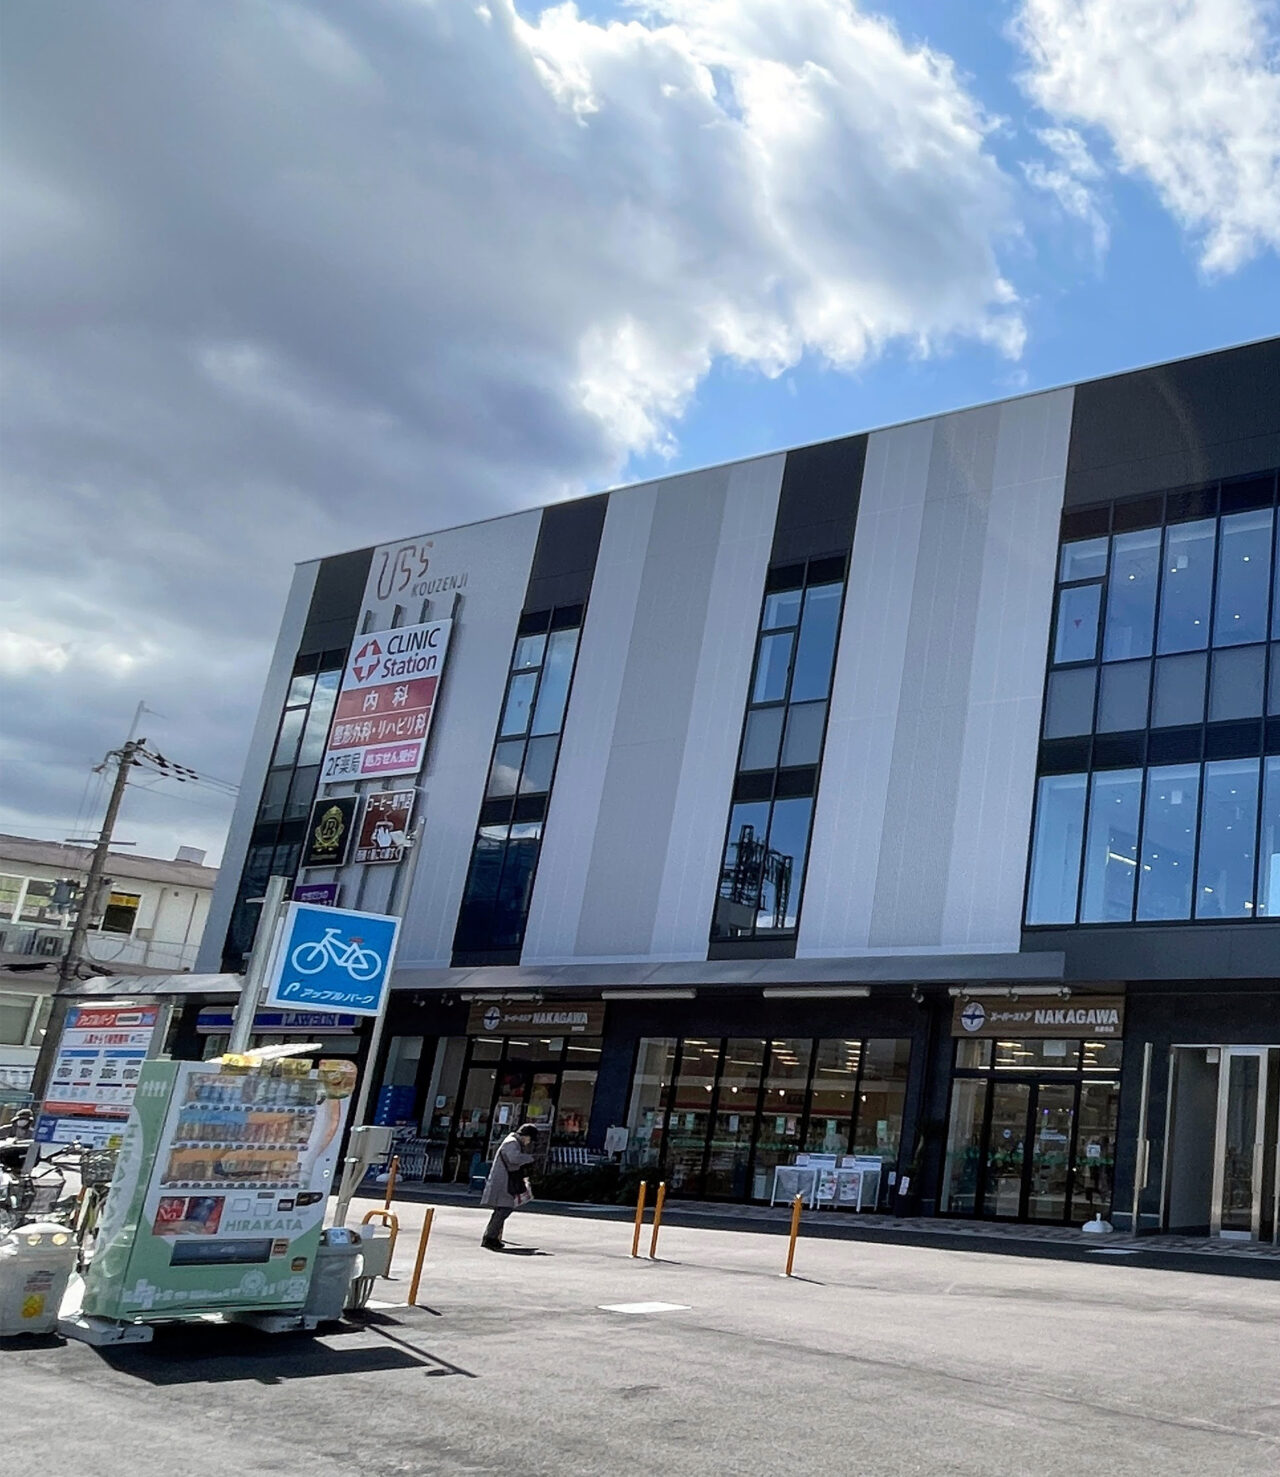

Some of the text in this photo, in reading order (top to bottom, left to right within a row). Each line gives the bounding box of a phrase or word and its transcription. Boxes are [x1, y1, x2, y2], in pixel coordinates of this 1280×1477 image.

[411, 572, 469, 597] KOUZENJI
[387, 628, 441, 655] CLINIC
[381, 653, 438, 678] Station
[363, 684, 409, 712] 内科
[532, 1012, 588, 1024] NAKAGAWA
[1034, 1009, 1119, 1025] NAKAGAWA
[225, 1218, 303, 1232] HIRAKATA
